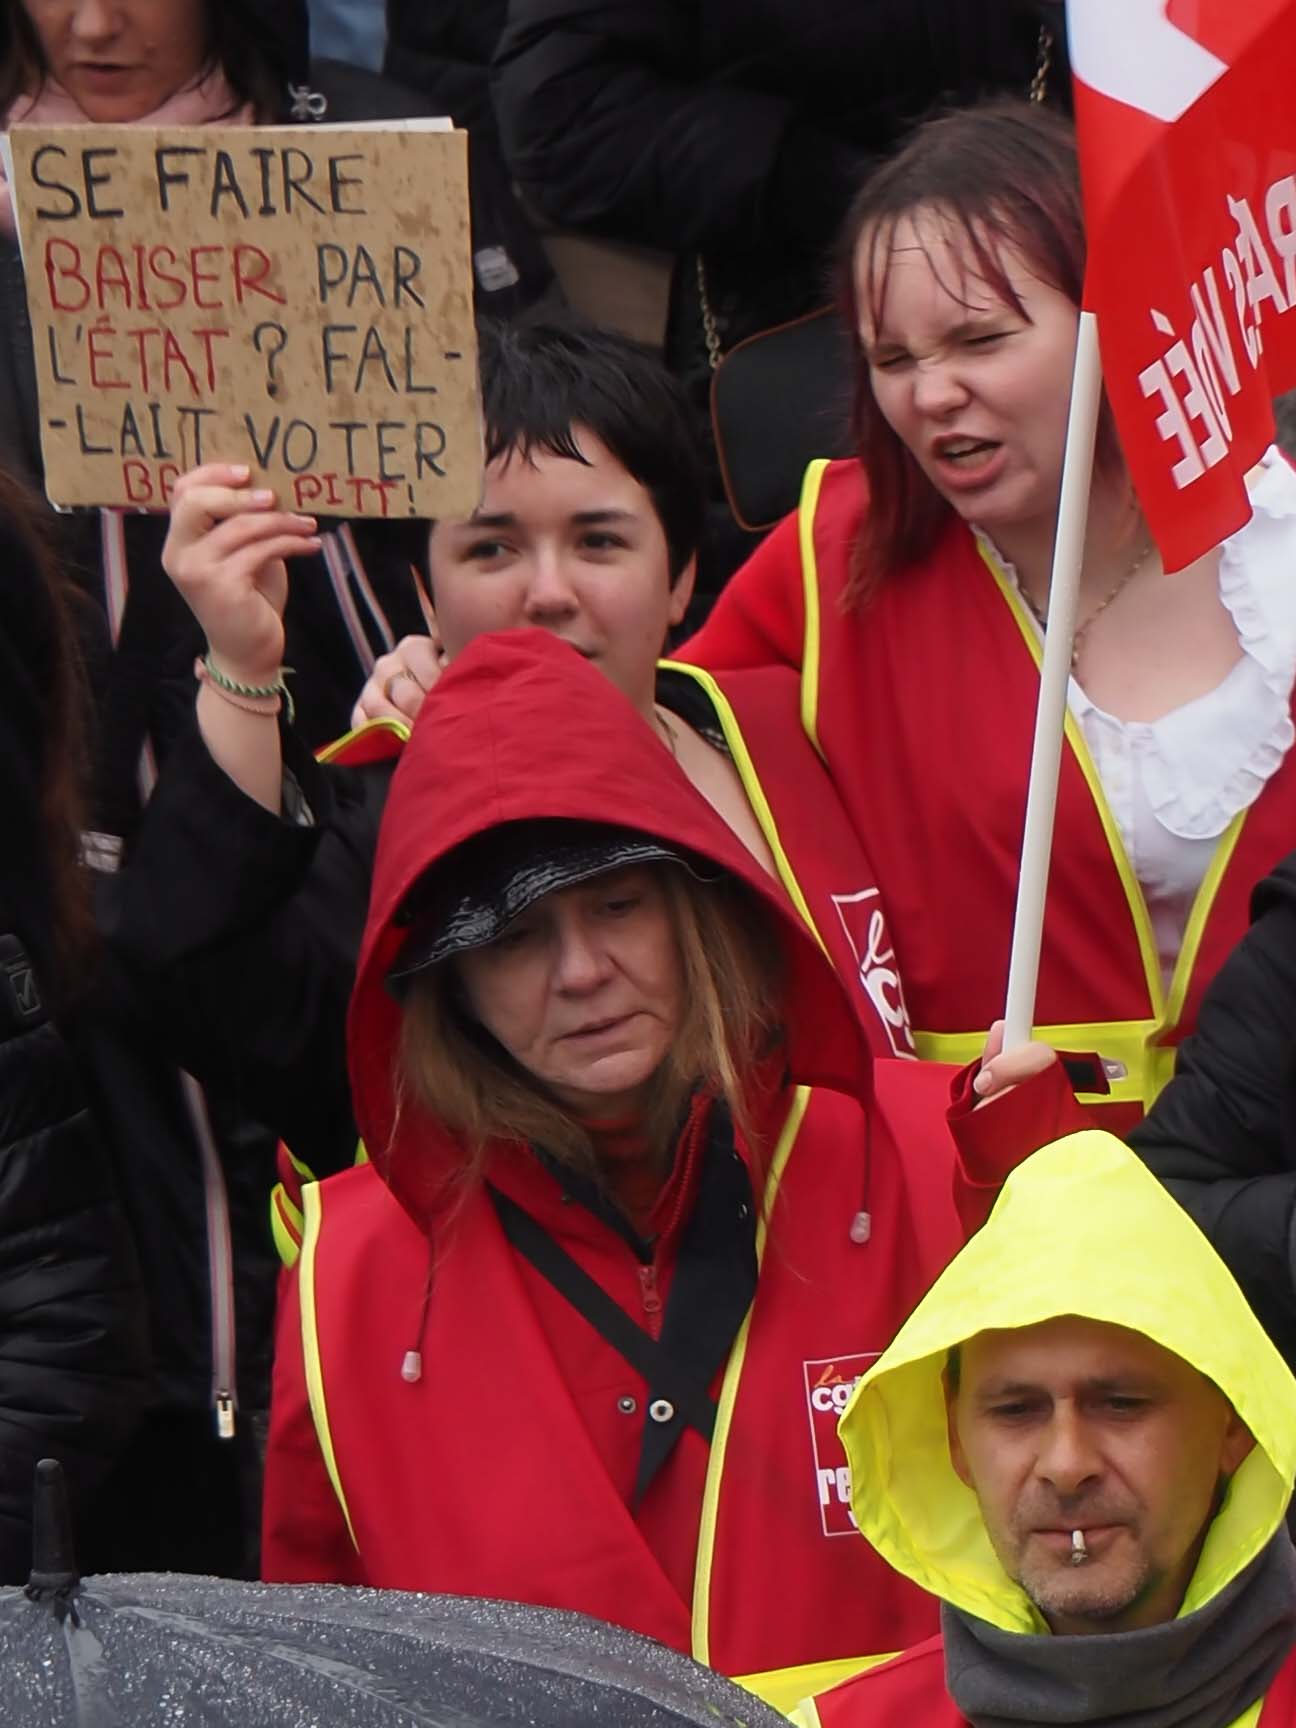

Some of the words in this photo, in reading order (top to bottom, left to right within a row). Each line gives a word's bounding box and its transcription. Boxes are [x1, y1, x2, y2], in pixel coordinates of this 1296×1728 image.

[31, 145, 124, 221] SE
[155, 147, 368, 219] FAIRE
[45, 238, 287, 312] BAISER
[317, 243, 425, 309] PAR
[49, 315, 230, 395] L'ÉTAT
[245, 413, 447, 481] VOTER
[811, 1376, 864, 1414] cg
